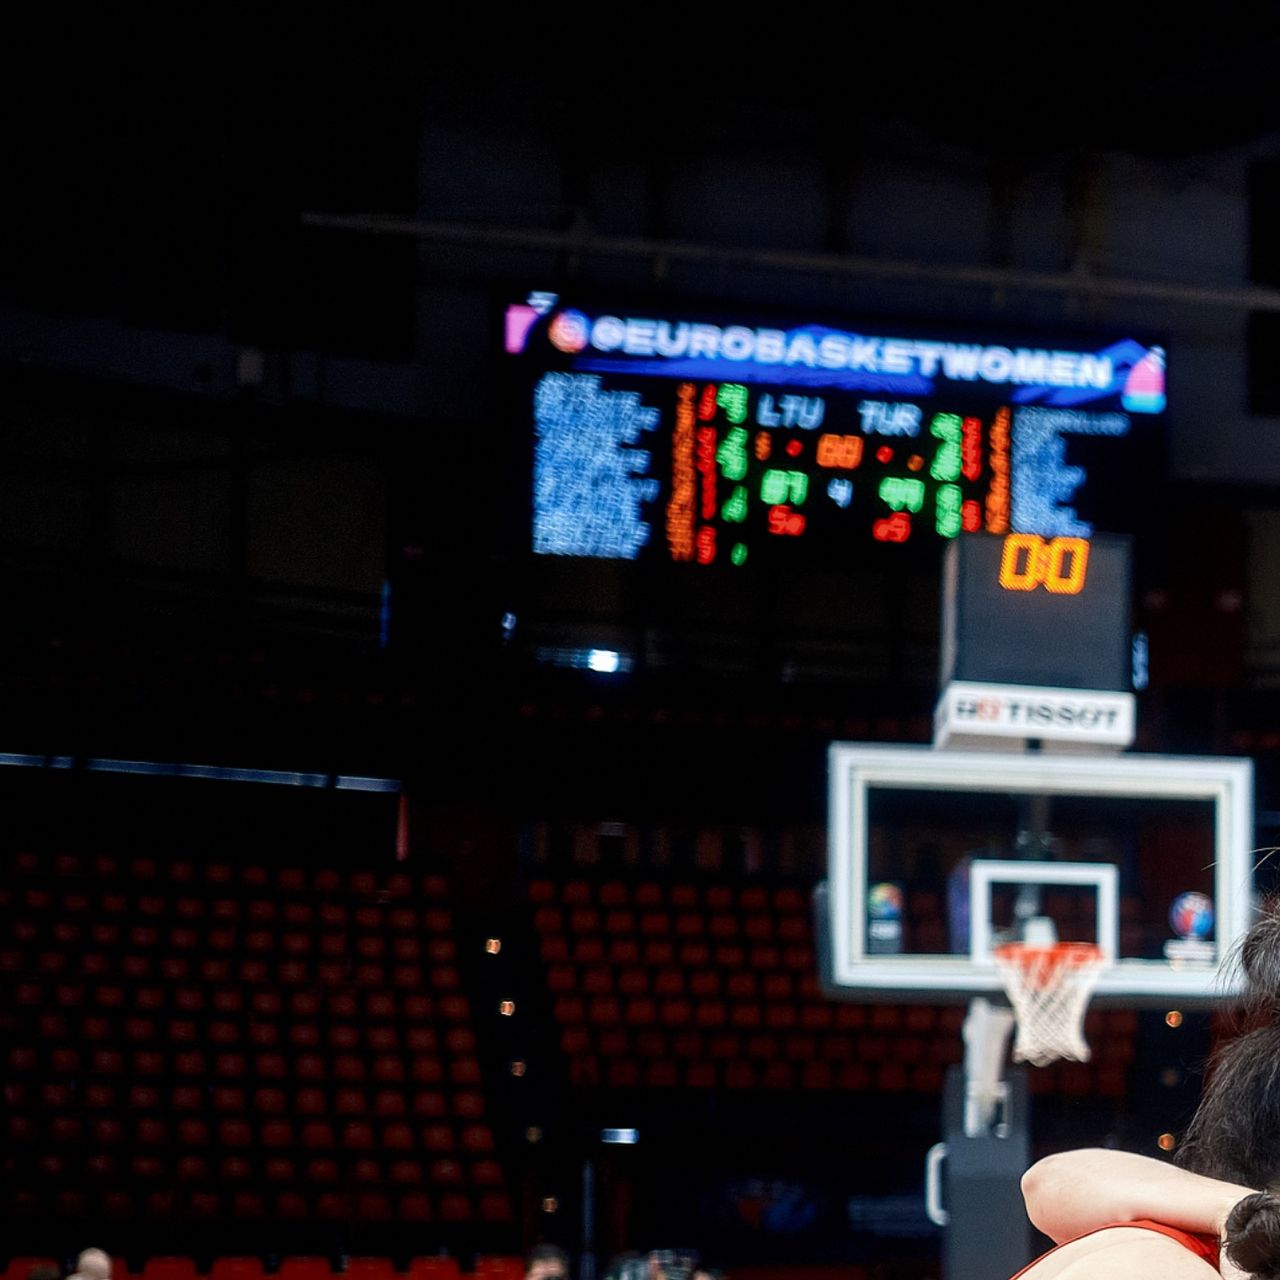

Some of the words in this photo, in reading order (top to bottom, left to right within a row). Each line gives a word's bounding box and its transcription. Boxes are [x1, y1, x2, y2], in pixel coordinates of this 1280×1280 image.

[591, 315, 1114, 390] @EUROBASKETWOMEN
[756, 392, 825, 431] LTU
[857, 400, 923, 438] TUR
[1008, 701, 1119, 729] TISSOT
